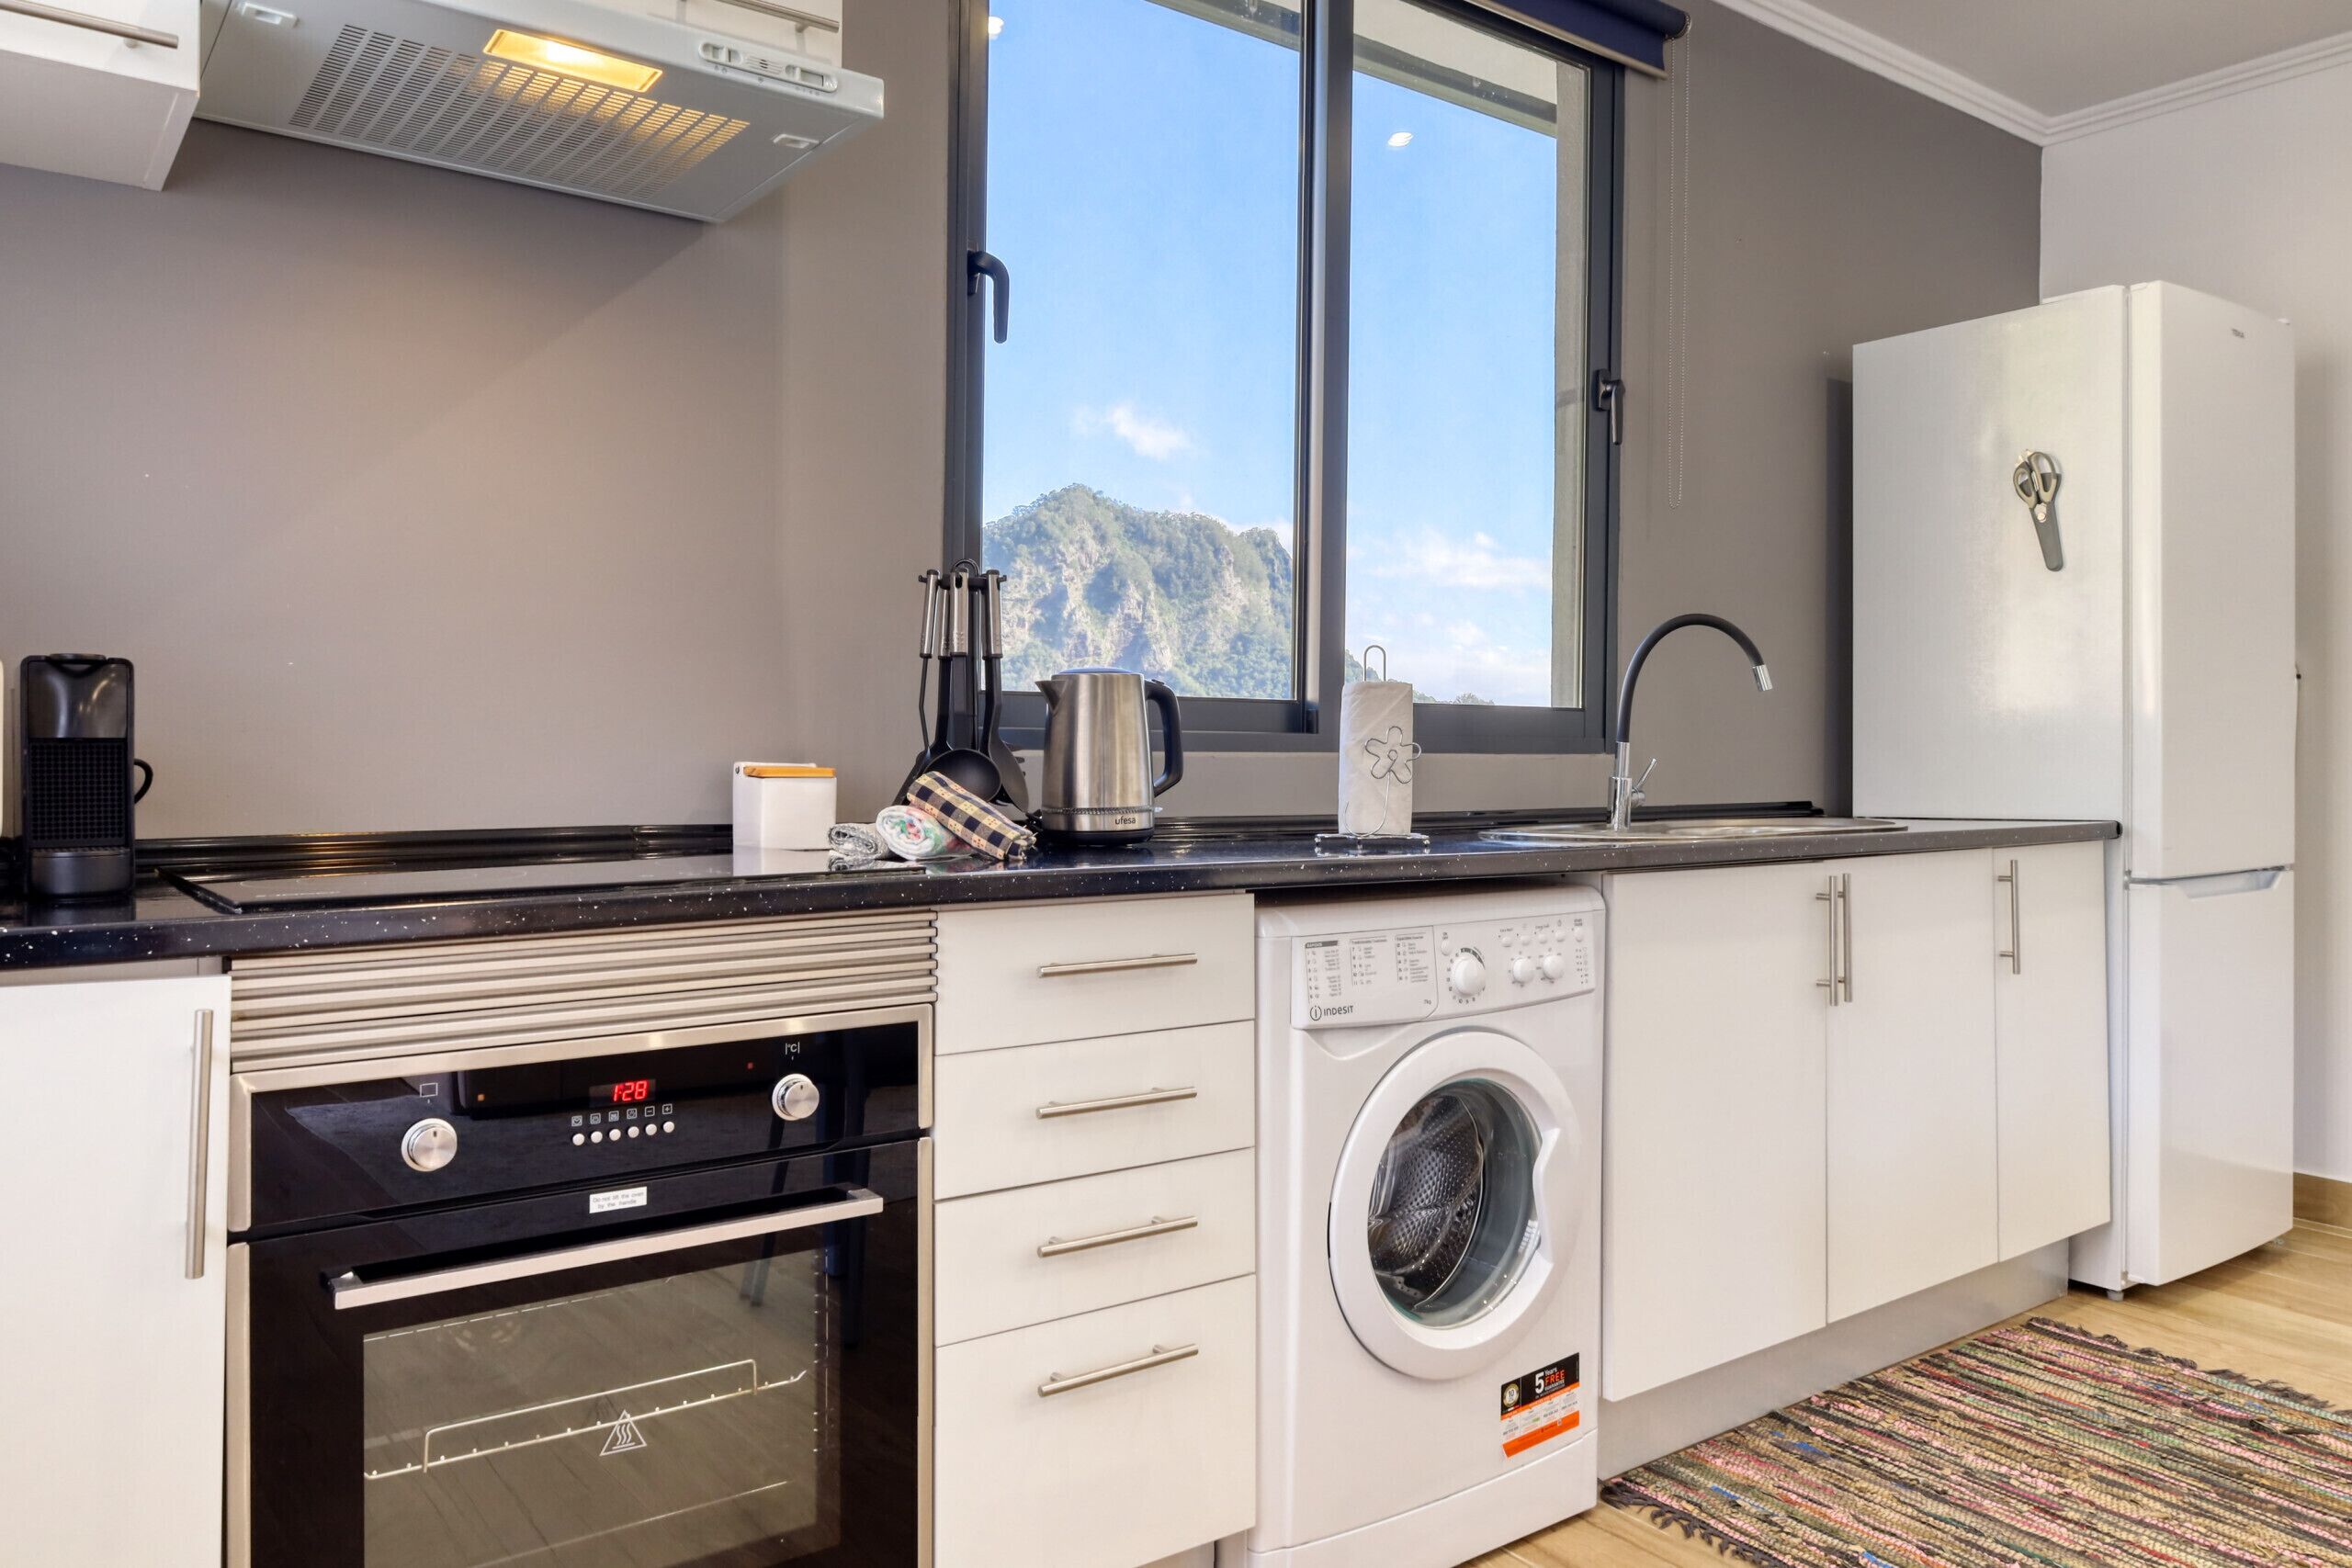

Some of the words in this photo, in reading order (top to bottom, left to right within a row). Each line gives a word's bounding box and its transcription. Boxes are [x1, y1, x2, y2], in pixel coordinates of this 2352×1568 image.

[1114, 816, 1136, 825] ufesa
[613, 1079, 648, 1101] 1:28
[1544, 1367, 1557, 1376] Years
[1545, 1370, 1565, 1386] FREE
[1535, 1371, 1544, 1394] 5
